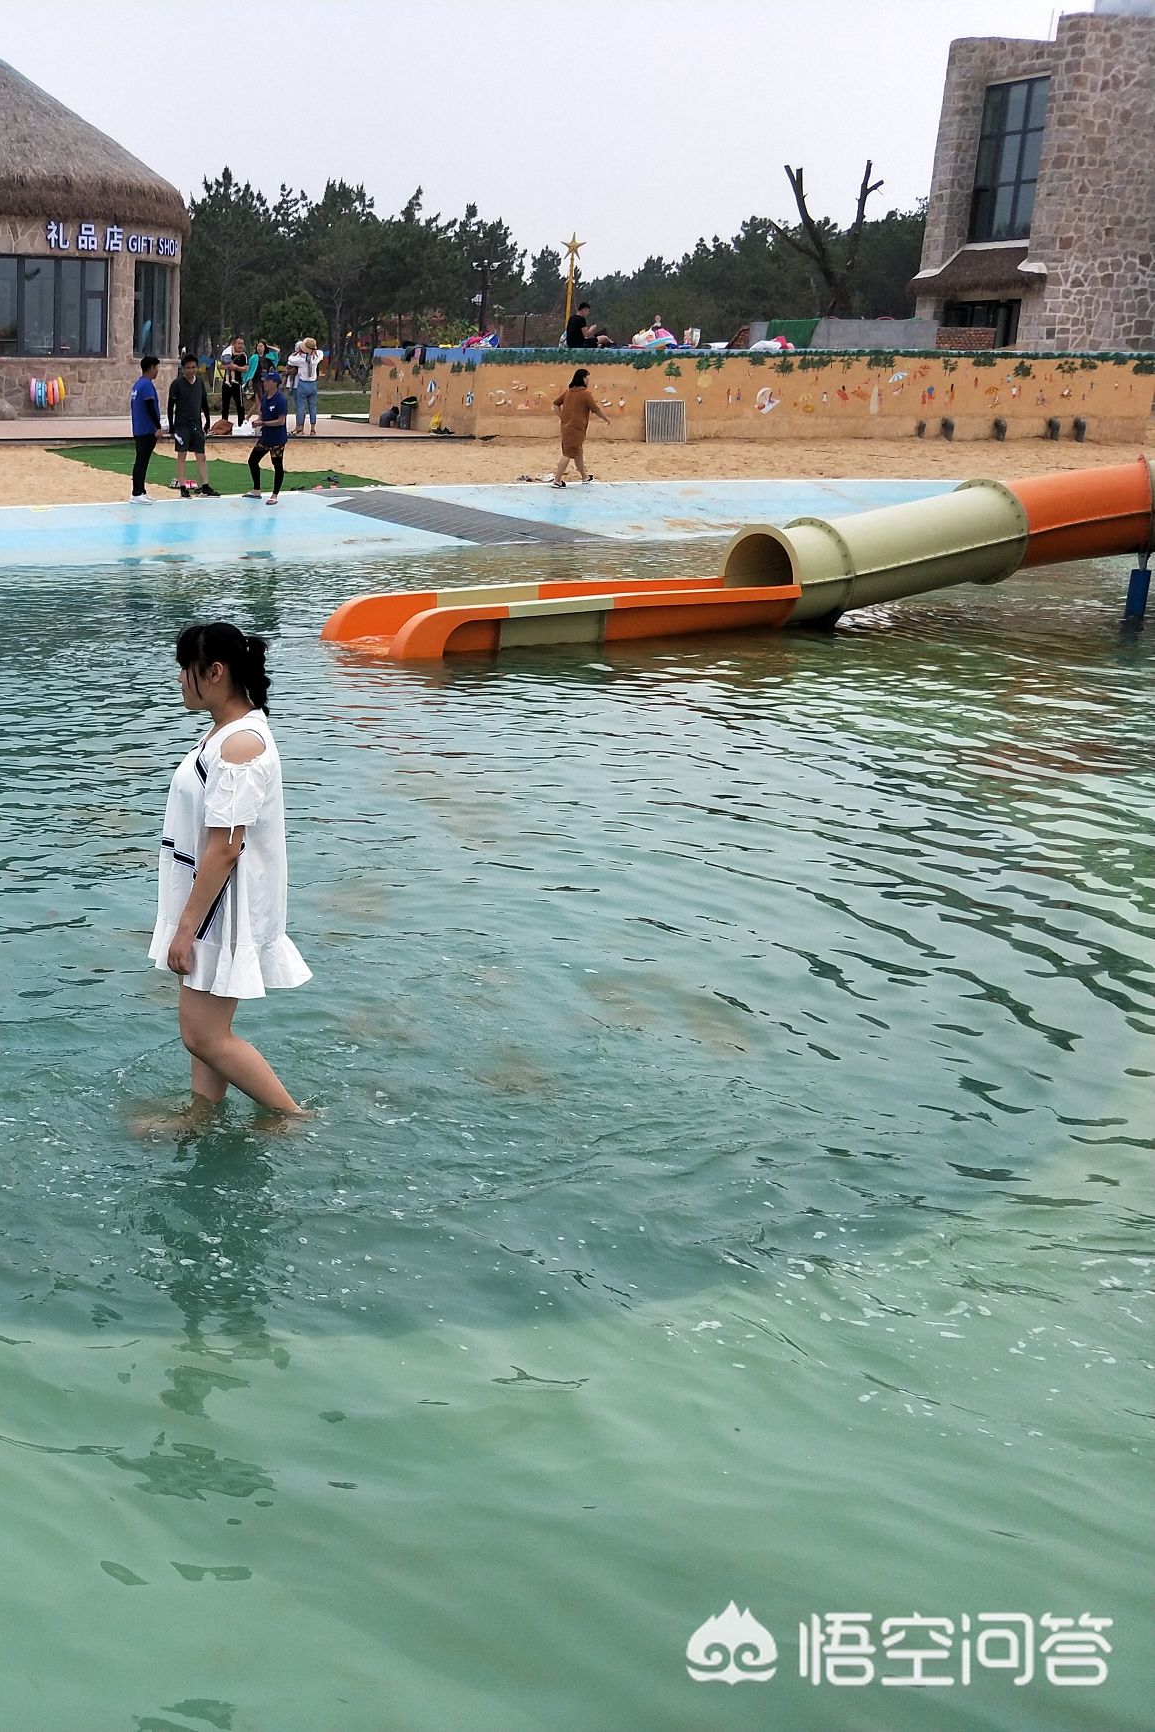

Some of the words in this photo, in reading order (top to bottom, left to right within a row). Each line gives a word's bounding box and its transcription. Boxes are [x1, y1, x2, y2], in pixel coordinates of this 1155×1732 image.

[46, 221, 124, 252] 礼品店
[127, 234, 155, 255] GIFT
[157, 236, 179, 257] SHOP
